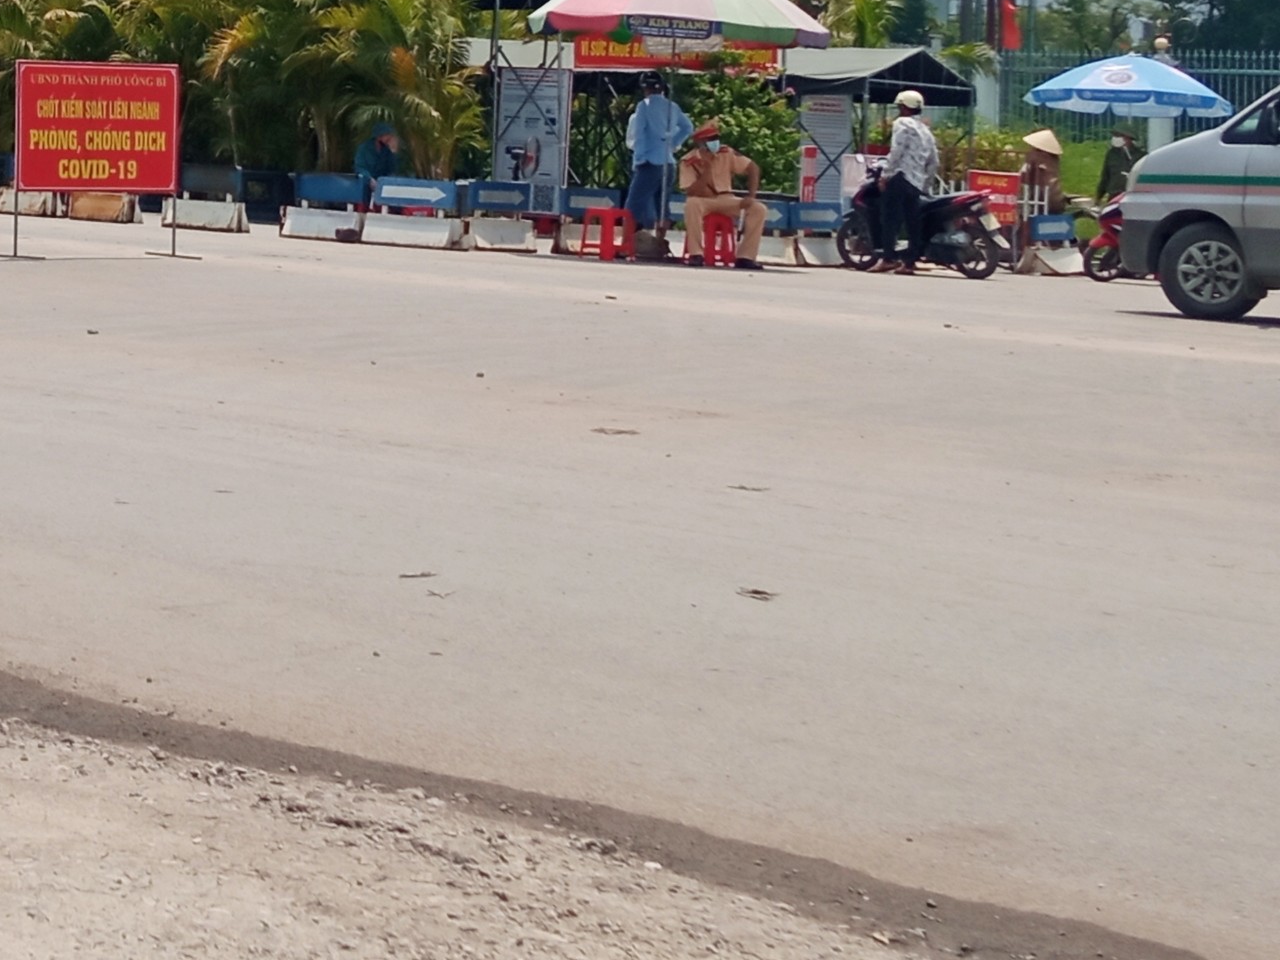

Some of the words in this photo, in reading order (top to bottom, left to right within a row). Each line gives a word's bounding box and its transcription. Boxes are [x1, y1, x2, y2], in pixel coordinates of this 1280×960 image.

[649, 18, 670, 28] KIM
[672, 19, 710, 29] TRANG
[30, 73, 59, 85] UBND
[62, 73, 97, 86] THÀNH
[100, 73, 123, 87] PHỐ
[37, 94, 59, 118] CHỐT
[86, 96, 107, 119] SOÁT
[109, 96, 128, 120] LIÊN
[130, 97, 160, 120] NGÀNH
[29, 125, 82, 154] PHÒNG,
[85, 124, 131, 151] CHỐNG
[134, 130, 166, 155] DỊCH
[58, 158, 137, 180] COVID-19
